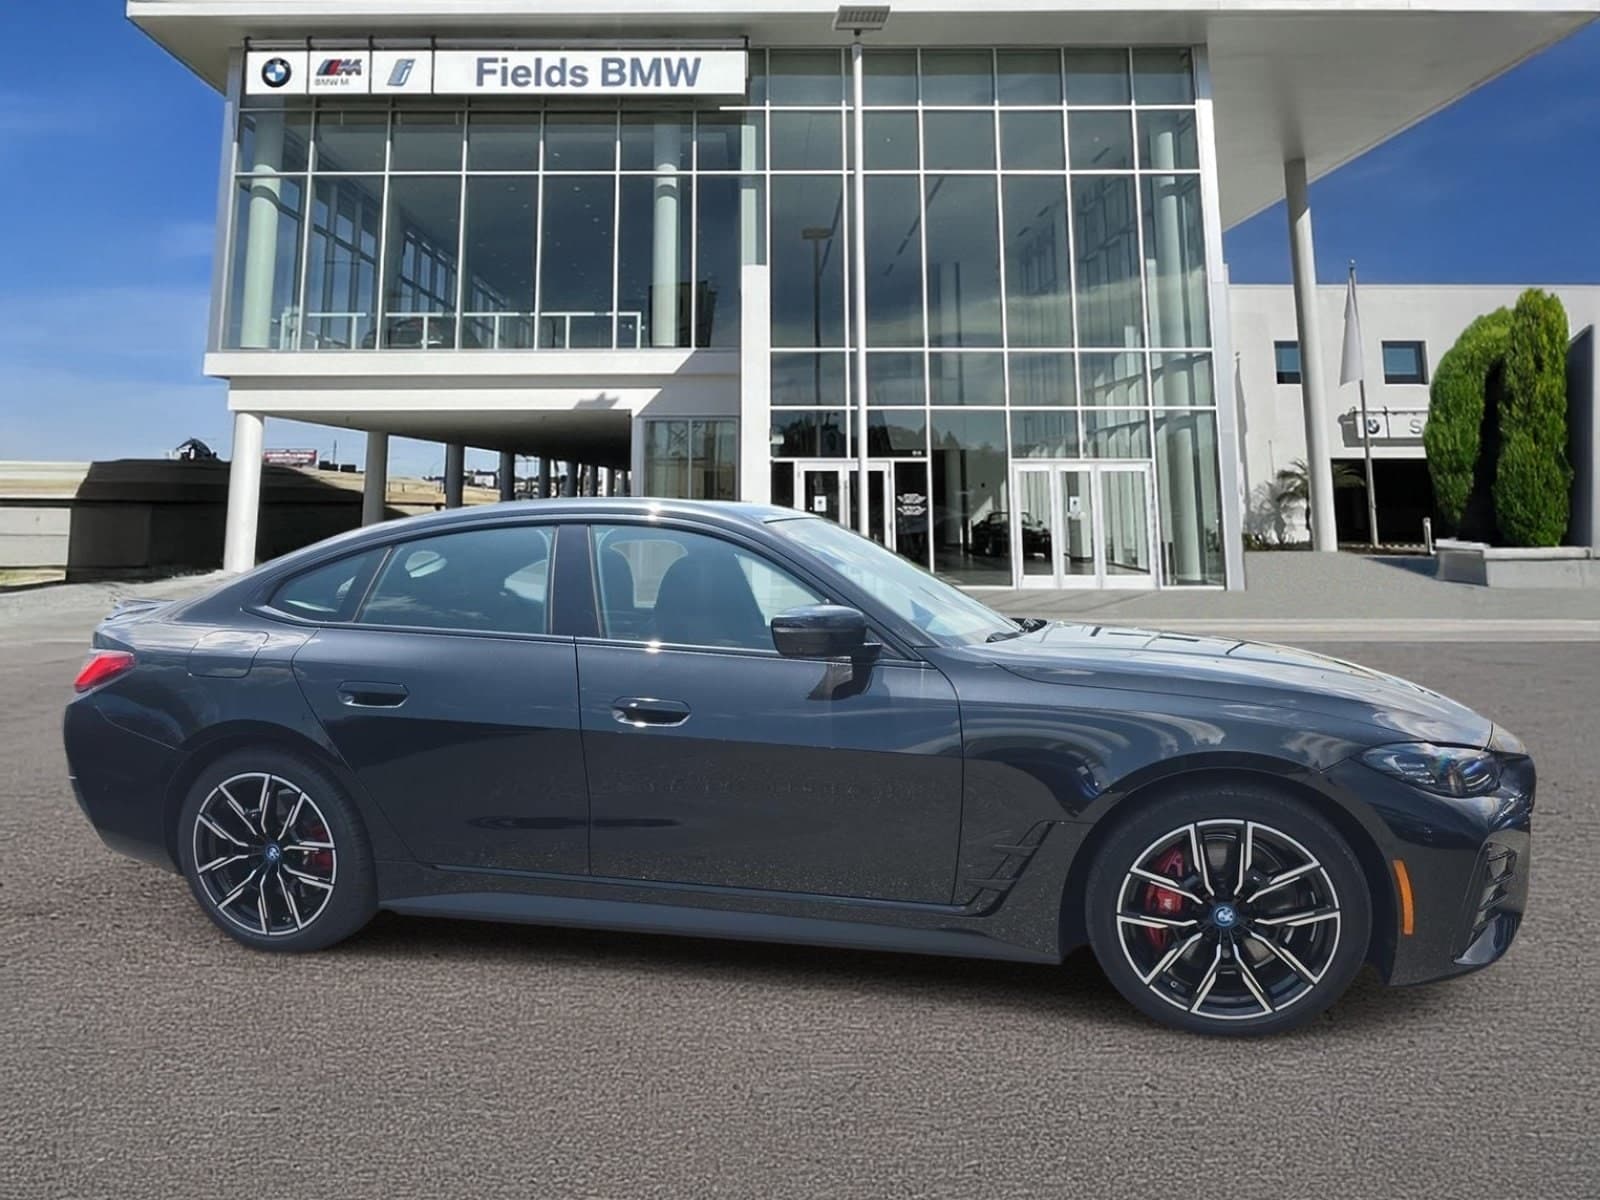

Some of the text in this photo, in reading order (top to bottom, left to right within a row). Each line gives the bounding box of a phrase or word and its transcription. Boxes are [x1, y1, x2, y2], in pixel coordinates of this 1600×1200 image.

[314, 78, 339, 86] BMW
[475, 57, 702, 88] Fields BMW
